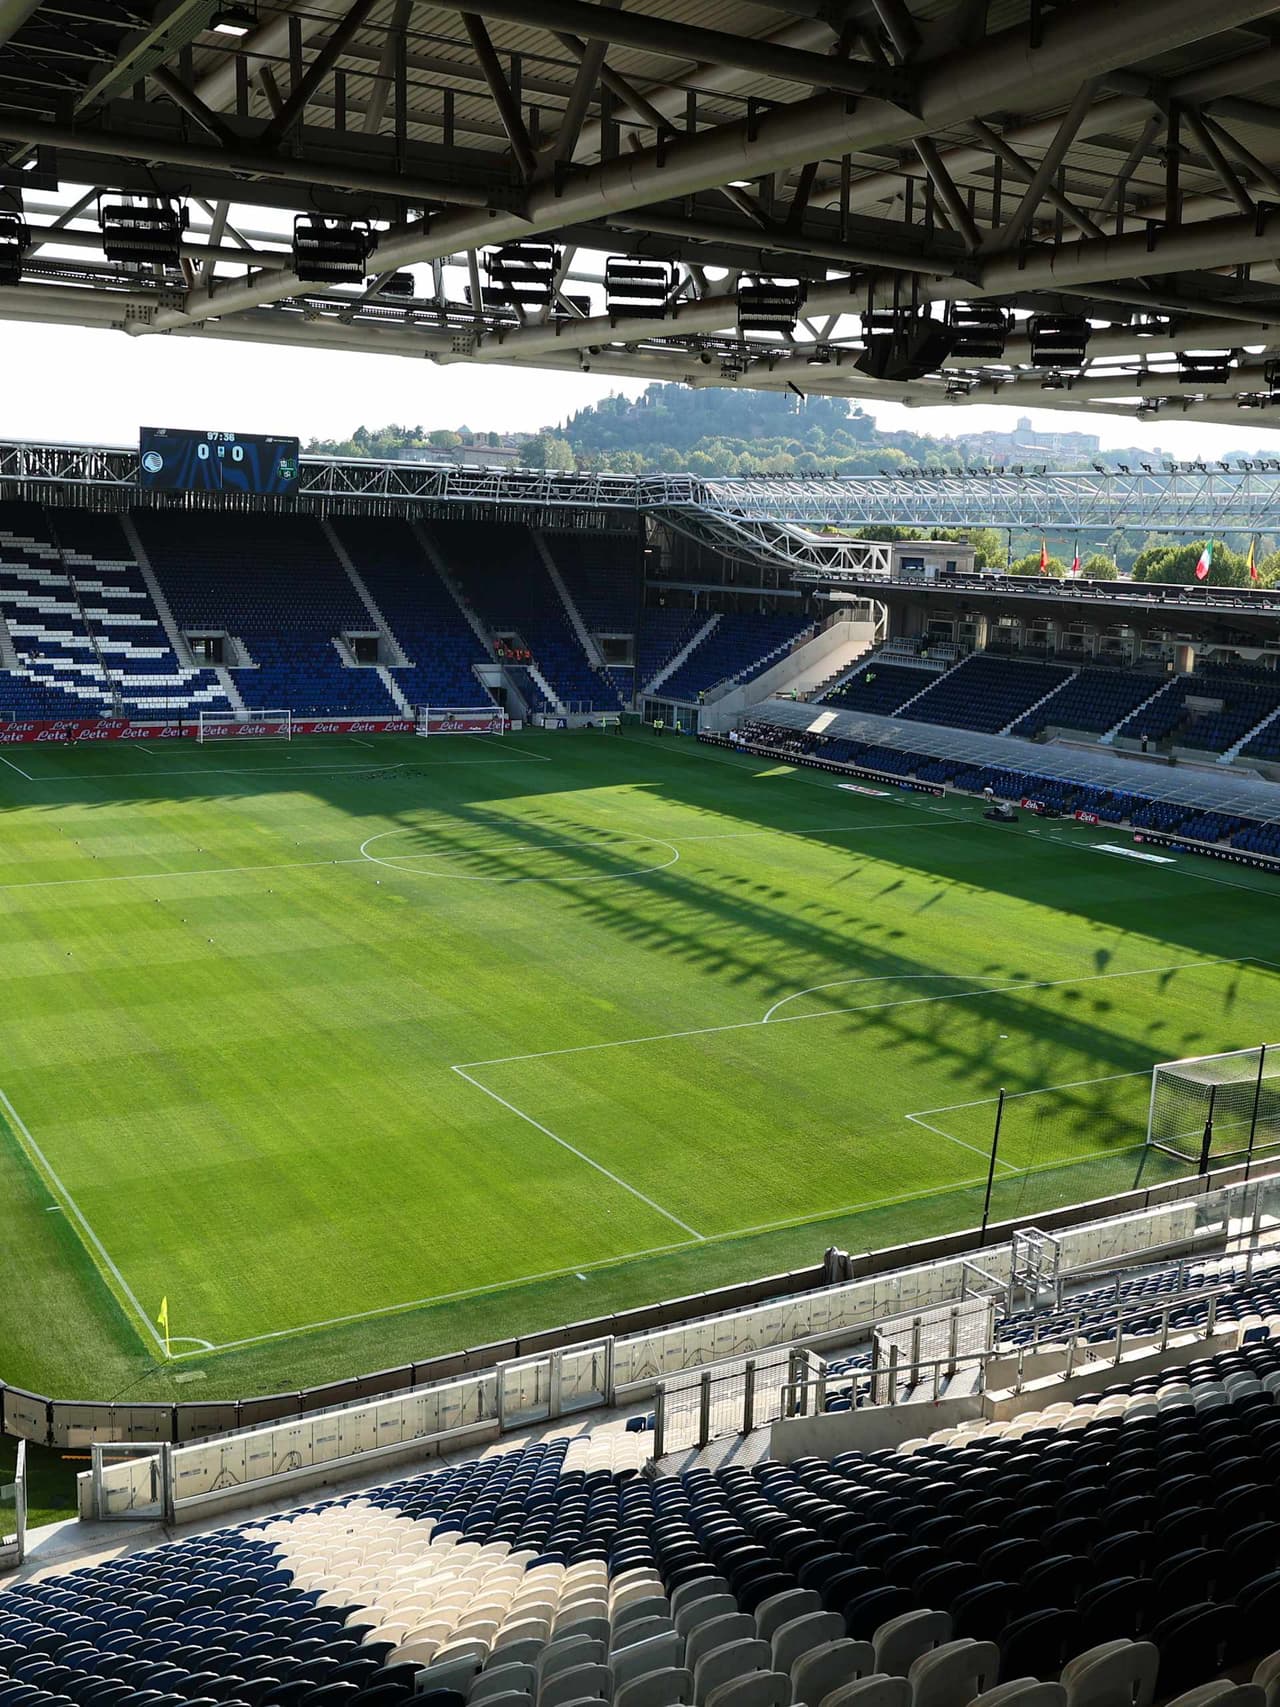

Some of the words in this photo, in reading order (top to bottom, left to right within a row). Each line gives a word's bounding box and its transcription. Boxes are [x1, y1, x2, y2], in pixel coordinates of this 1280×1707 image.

[197, 443, 210, 460] 0
[231, 445, 244, 462] 0
[4, 722, 34, 731] Lete
[95, 720, 122, 729] Lete
[33, 730, 67, 741] Lete
[76, 729, 108, 740] Lete
[117, 728, 150, 738] Lete
[199, 725, 229, 736] Lete
[236, 724, 266, 735] Lete
[311, 723, 339, 733] Lete
[347, 722, 375, 732] Lete
[382, 721, 410, 731] Lete
[438, 721, 464, 731] Lete
[1214, 851, 1248, 863] VOLVO
